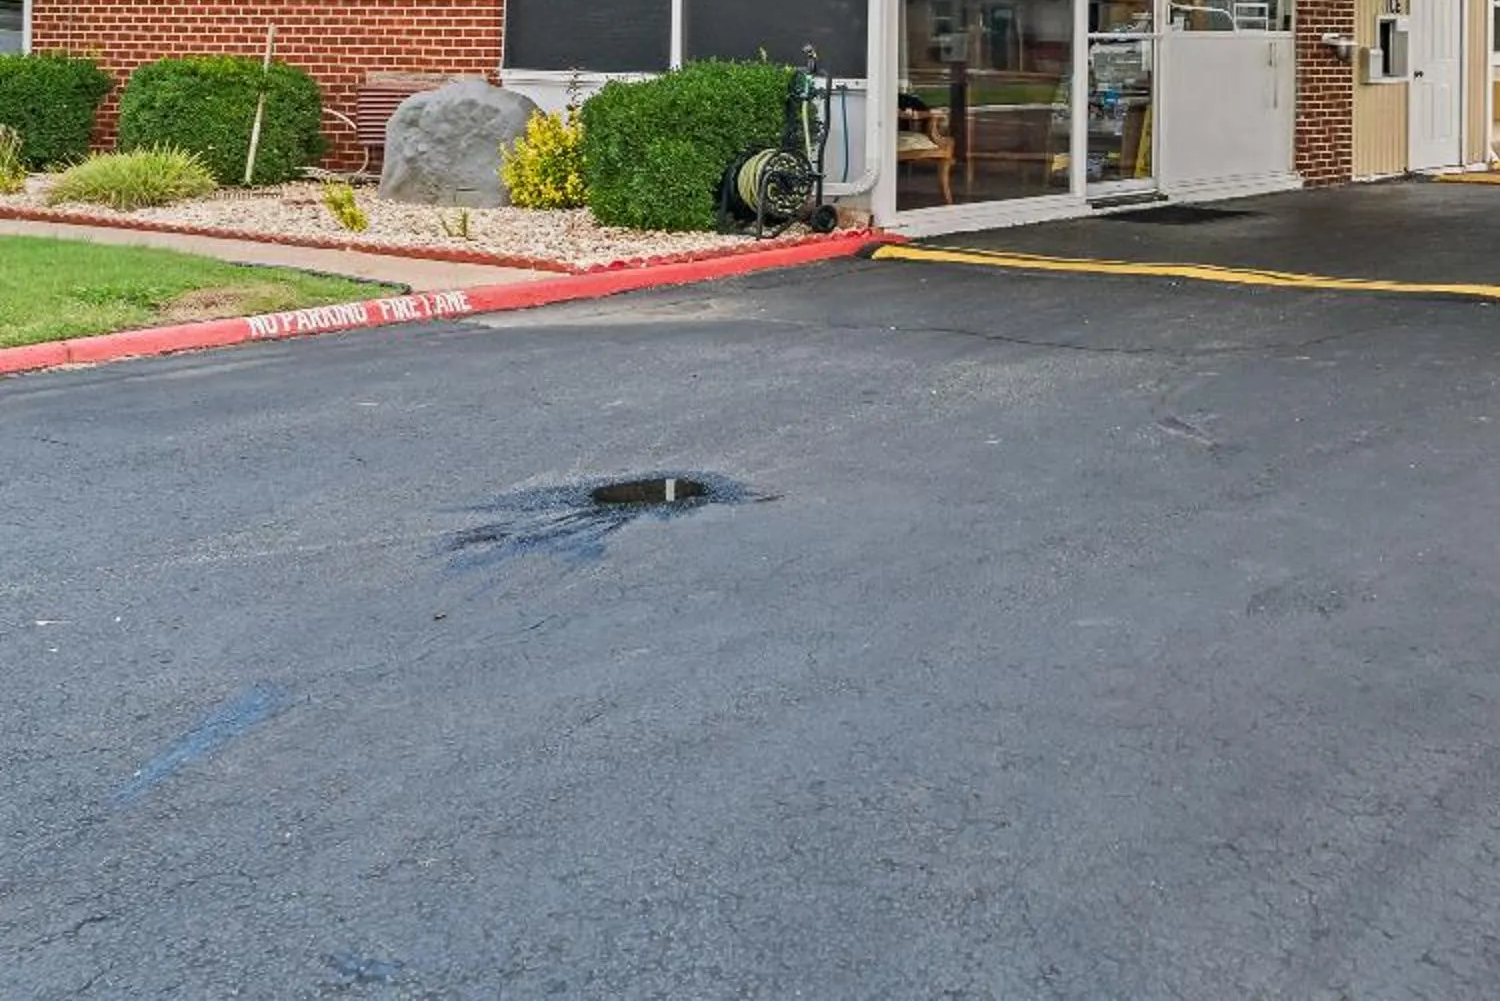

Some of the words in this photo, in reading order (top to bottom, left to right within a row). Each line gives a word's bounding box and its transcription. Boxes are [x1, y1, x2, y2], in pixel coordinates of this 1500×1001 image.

[248, 317, 279, 336] NO
[282, 302, 366, 331] PARKING
[380, 296, 420, 321] FIRE
[422, 291, 472, 315] LANE
